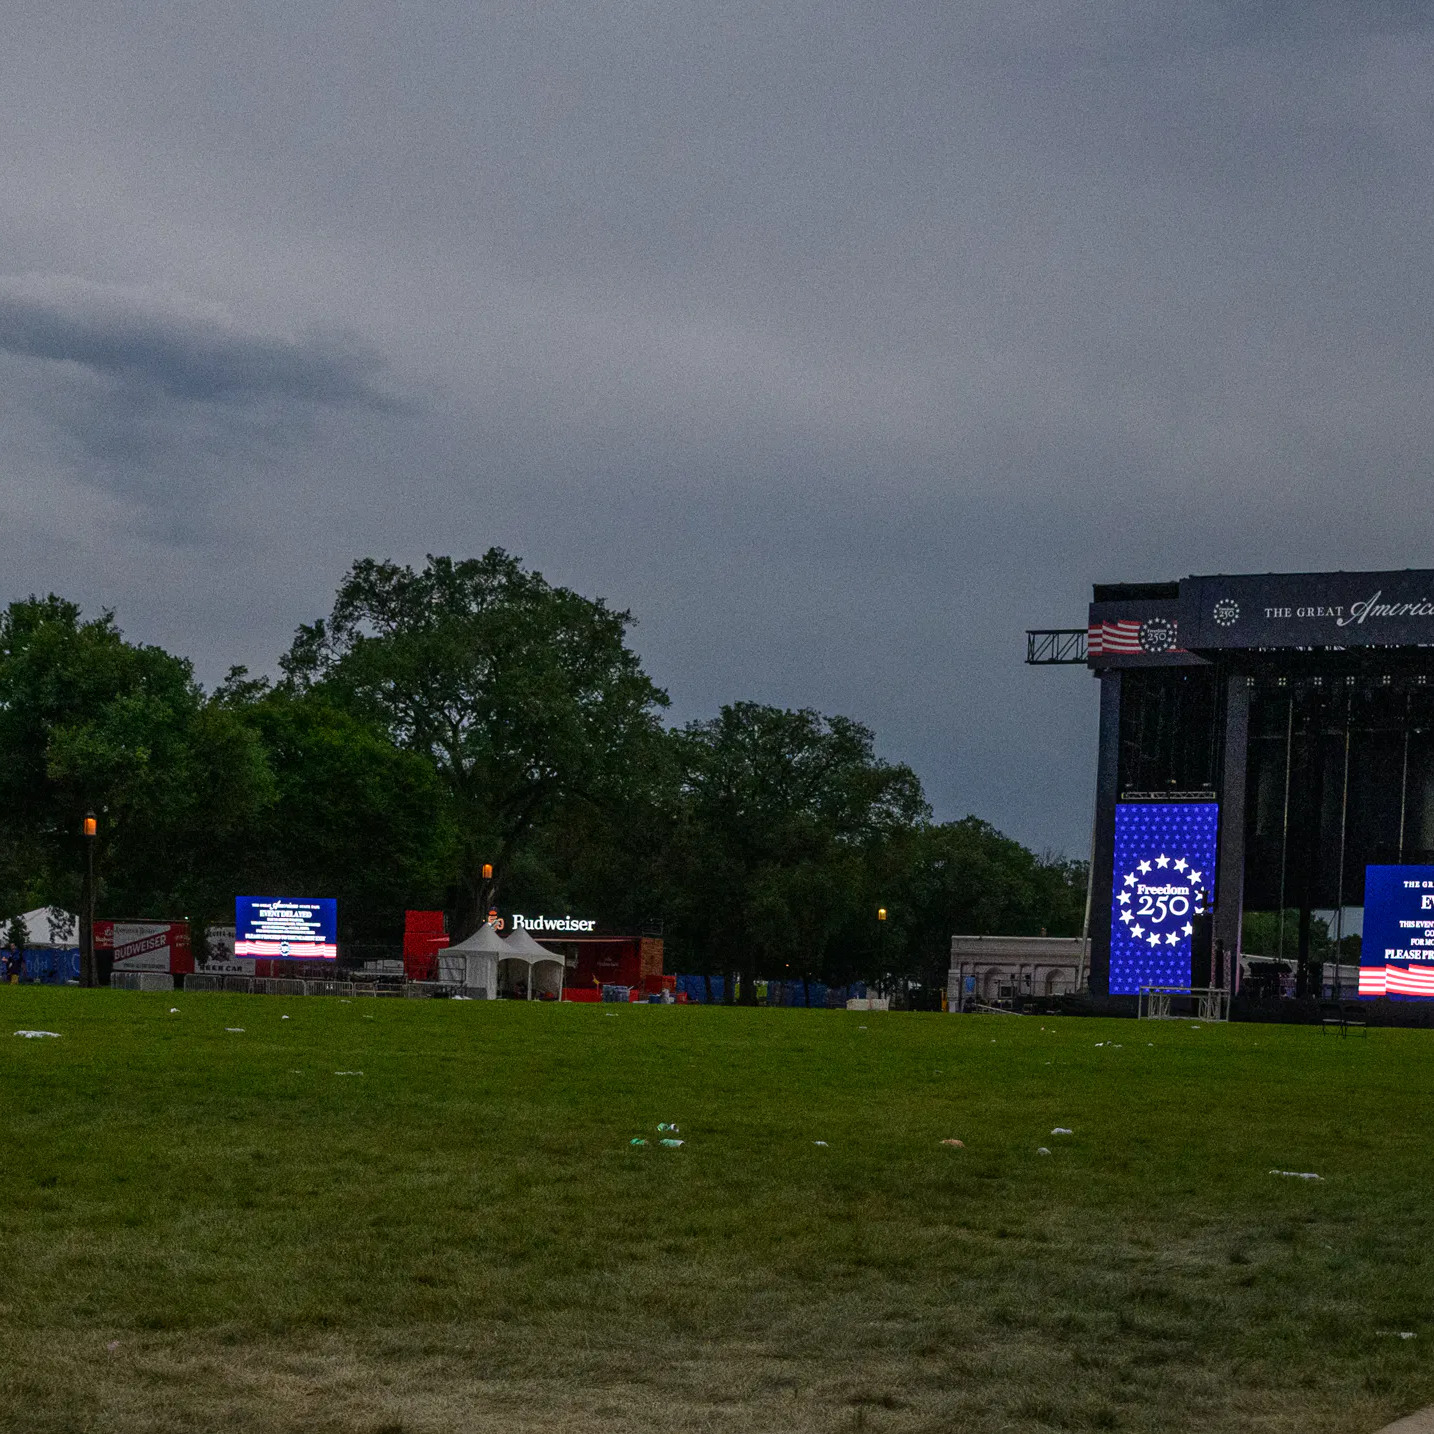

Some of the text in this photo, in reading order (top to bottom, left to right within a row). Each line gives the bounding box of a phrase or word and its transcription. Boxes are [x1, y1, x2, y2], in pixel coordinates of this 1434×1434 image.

[1219, 610, 1234, 619] 250
[1264, 608, 1294, 618] THE
[1296, 606, 1344, 618] GREAT
[1147, 632, 1166, 643] 250
[1137, 883, 1190, 895] Freedom
[1137, 895, 1189, 923] 250
[512, 914, 596, 931] Budweiser
[1399, 920, 1415, 928] THIS
[114, 934, 167, 960] BUDWEISER
[1385, 949, 1421, 959] PLEASE
